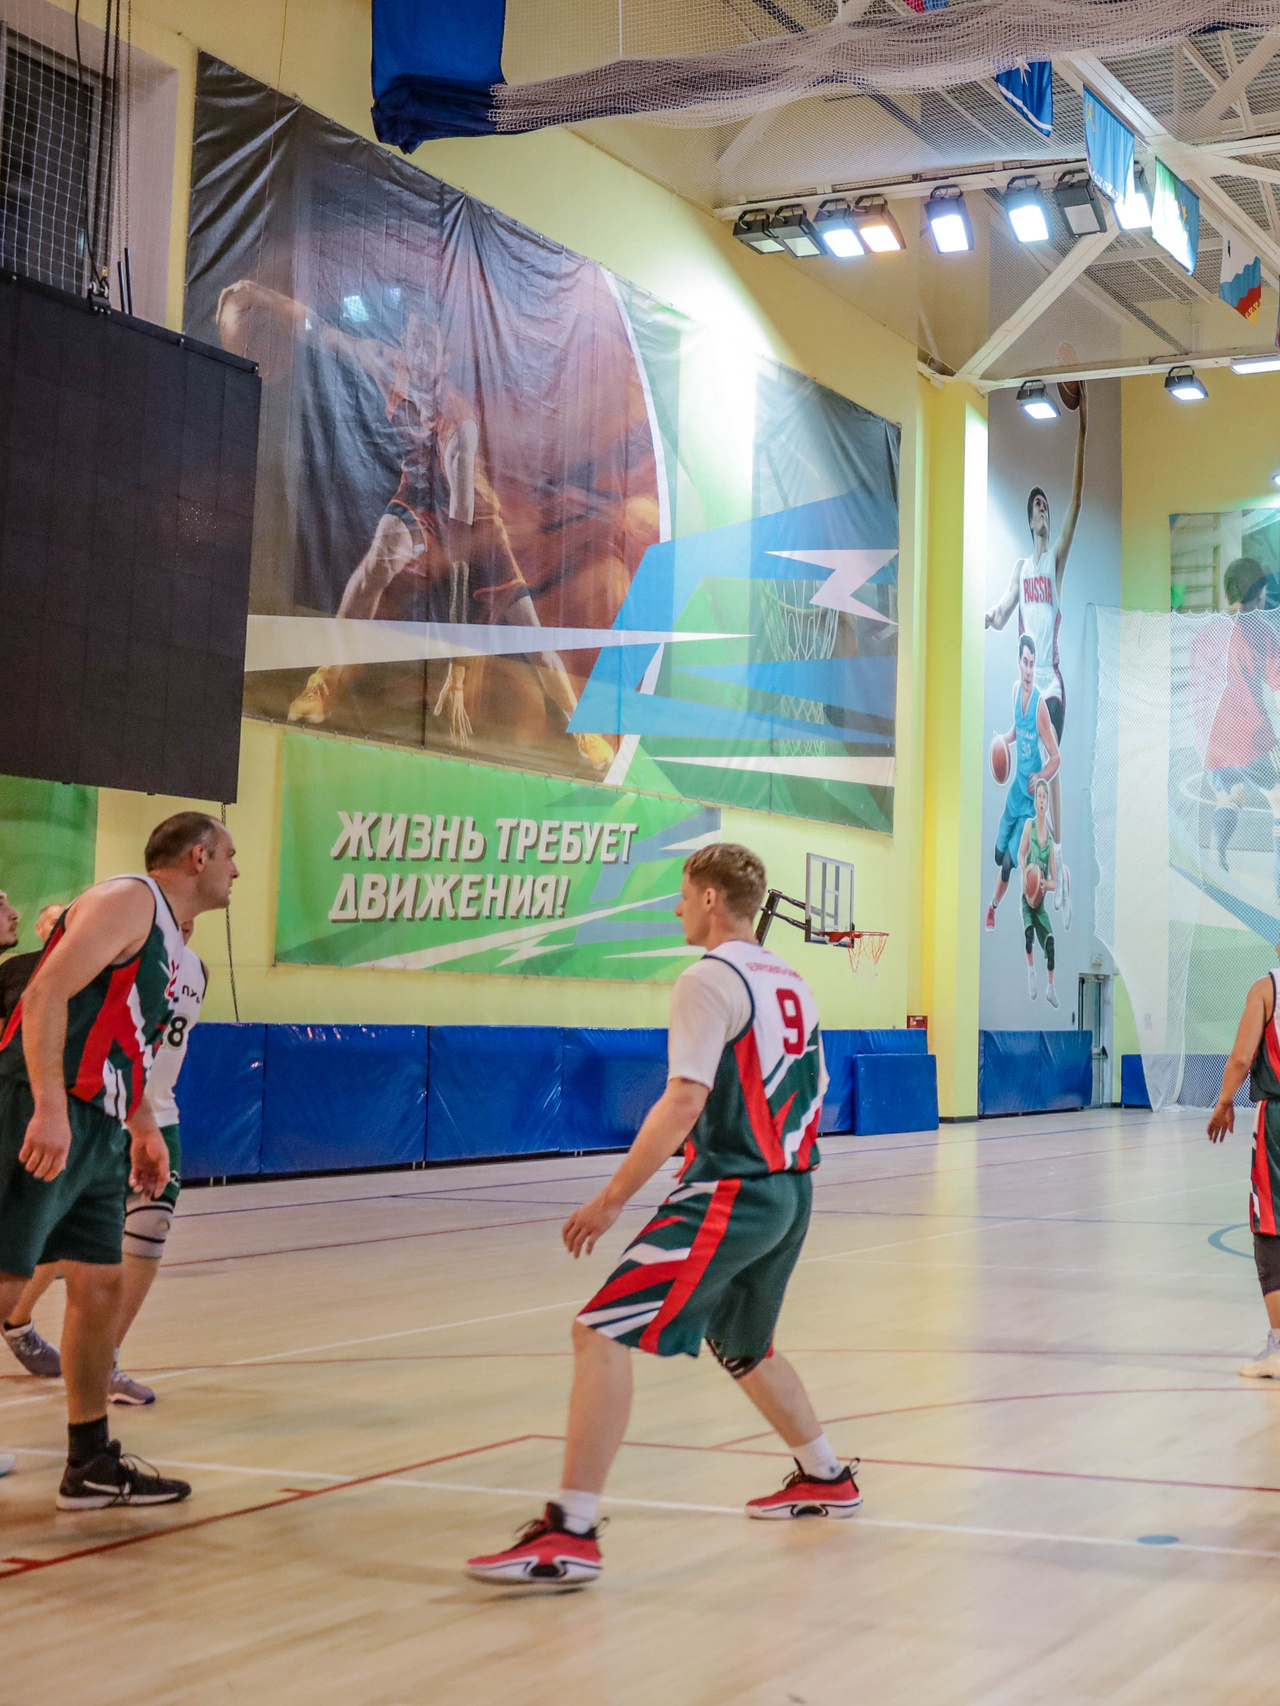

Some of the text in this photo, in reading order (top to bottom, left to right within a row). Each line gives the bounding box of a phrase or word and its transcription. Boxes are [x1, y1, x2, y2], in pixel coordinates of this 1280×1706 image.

[1023, 576, 1053, 606] RUSSIA
[330, 811, 639, 865] ЖИЗНЬ ТРЕБУЕТ
[328, 873, 572, 924] ДВИЖЕНИЯ!
[776, 987, 805, 1055] 9
